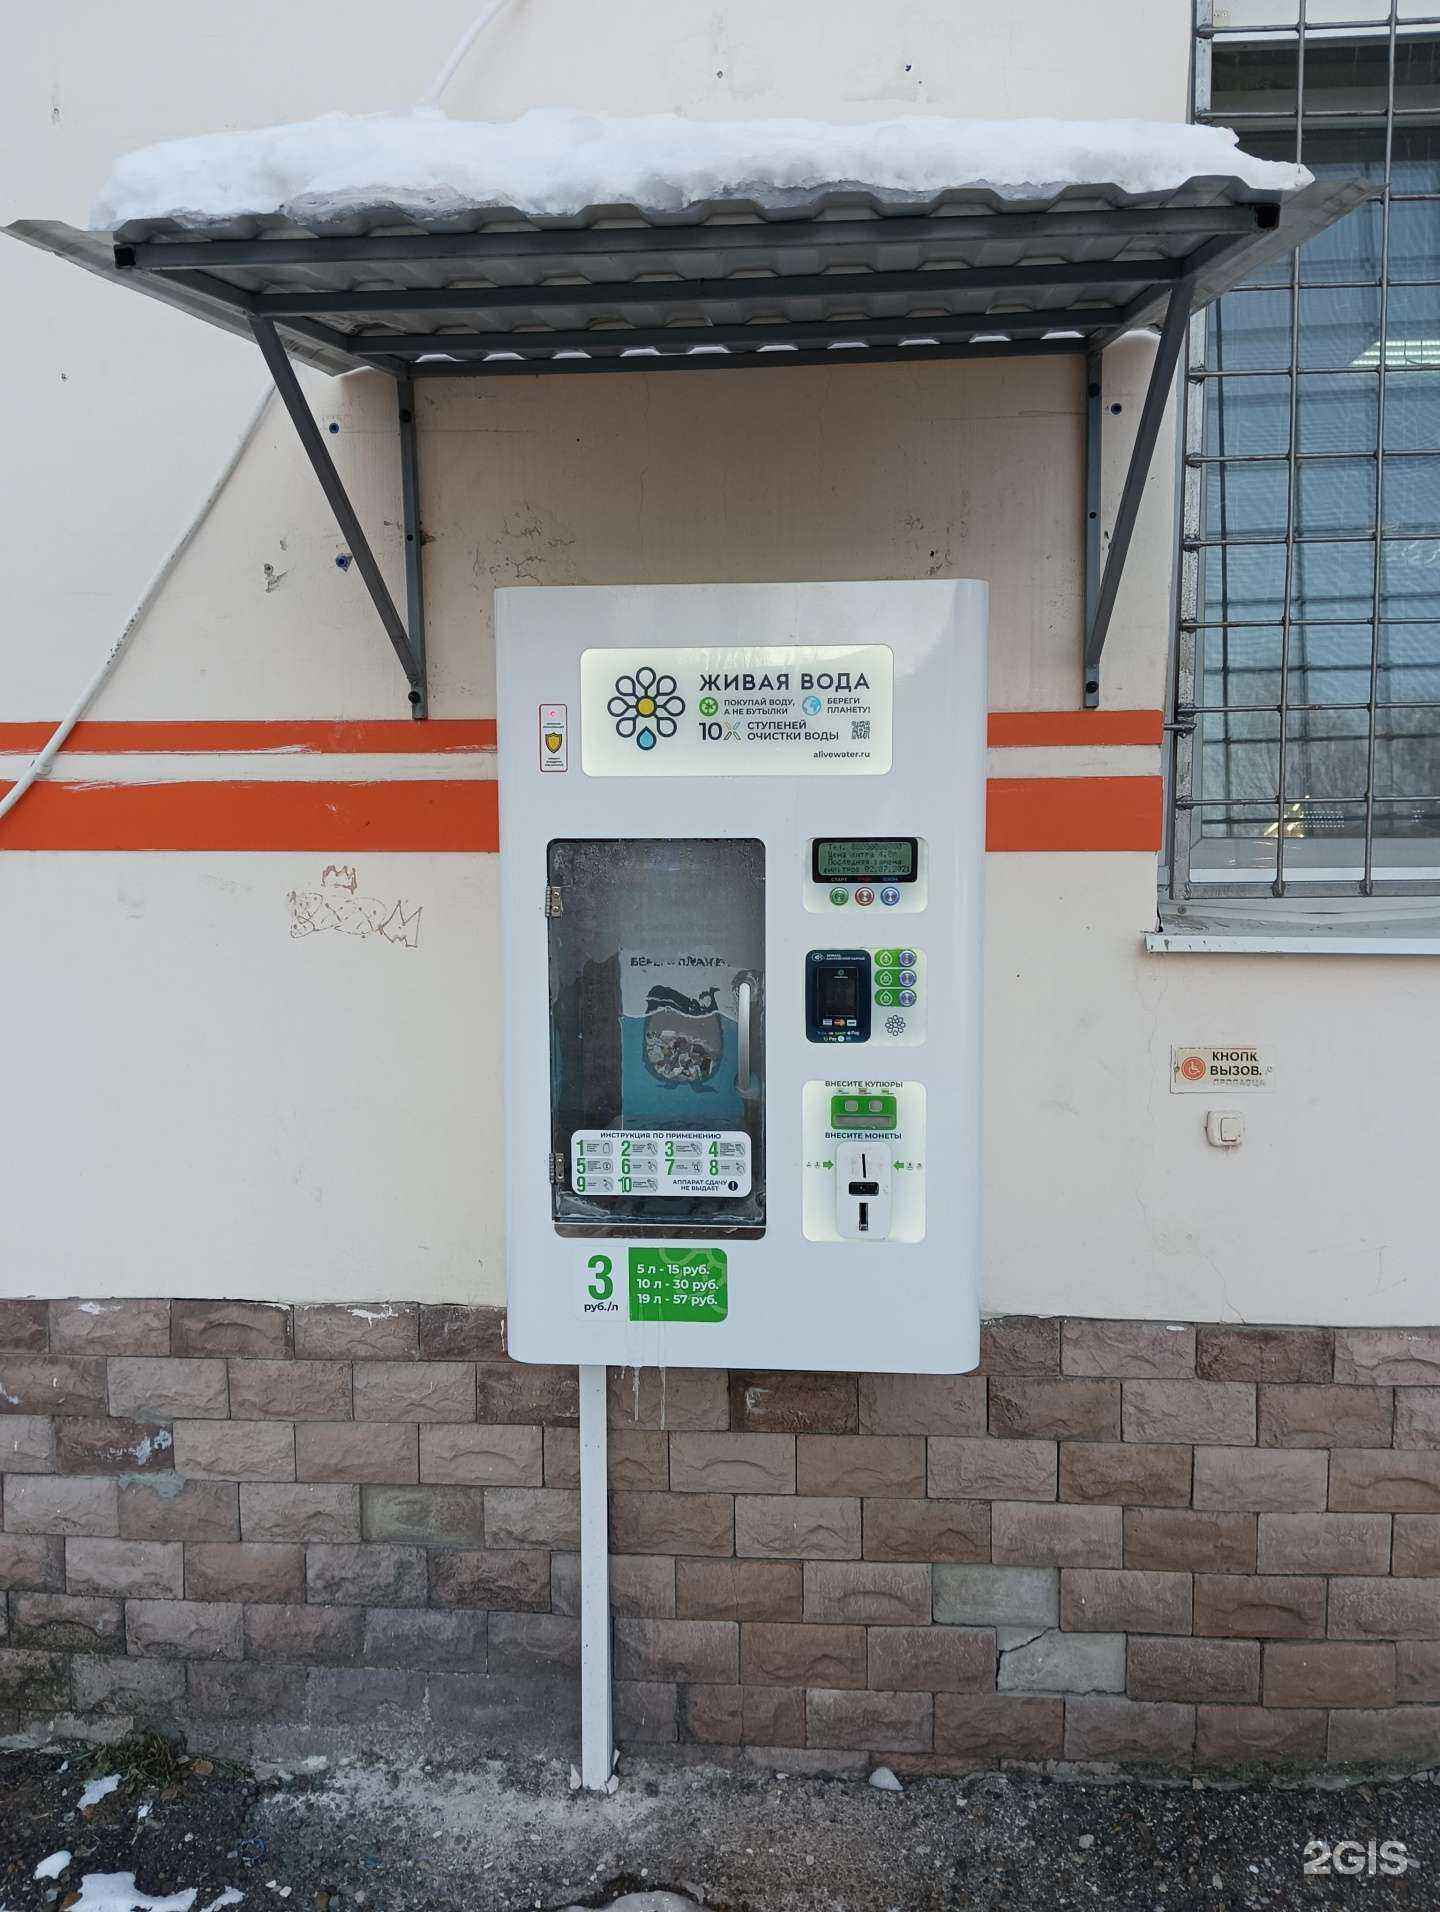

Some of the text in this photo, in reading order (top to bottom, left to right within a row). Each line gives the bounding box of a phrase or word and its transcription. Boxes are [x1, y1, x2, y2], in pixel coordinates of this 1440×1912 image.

[699, 672, 870, 692] ЖИВАЯ ВОДА
[724, 698, 795, 707] ПОКУПАЙ ВОДУ,
[827, 697, 860, 705] БЕРЕГИ
[827, 706, 871, 714] ПЛАНЕТУ!
[747, 720, 807, 730] СТУПЕНЕЙ
[747, 732, 839, 742] ОЧИСТКИ ВОДЫ
[1210, 1065, 1262, 1076] ВЫЗОВ
[600, 1132, 651, 1140] ИНСТРУКЦИЯ
[576, 1139, 584, 1156] 1
[621, 1140, 631, 1157] 2
[665, 1141, 674, 1157] 3
[708, 1141, 719, 1157] 4
[576, 1158, 586, 1174] 5
[621, 1158, 631, 1174] 6
[665, 1159, 675, 1175] 7
[709, 1159, 719, 1175] 8
[576, 1176, 586, 1192] 9
[618, 1176, 632, 1193] 10
[587, 1254, 614, 1300] 3
[636, 1264, 644, 1274] 5
[647, 1265, 656, 1274] л
[667, 1264, 679, 1274] 15
[683, 1264, 710, 1276] руб.
[636, 1278, 650, 1288] 10
[653, 1280, 662, 1288] л
[672, 1279, 689, 1289] 30
[692, 1279, 719, 1291] руб.
[584, 1302, 619, 1312] руб./л
[636, 1293, 650, 1303] 19
[653, 1295, 662, 1303] л
[673, 1294, 687, 1304] 57
[691, 1295, 718, 1306] руб.
